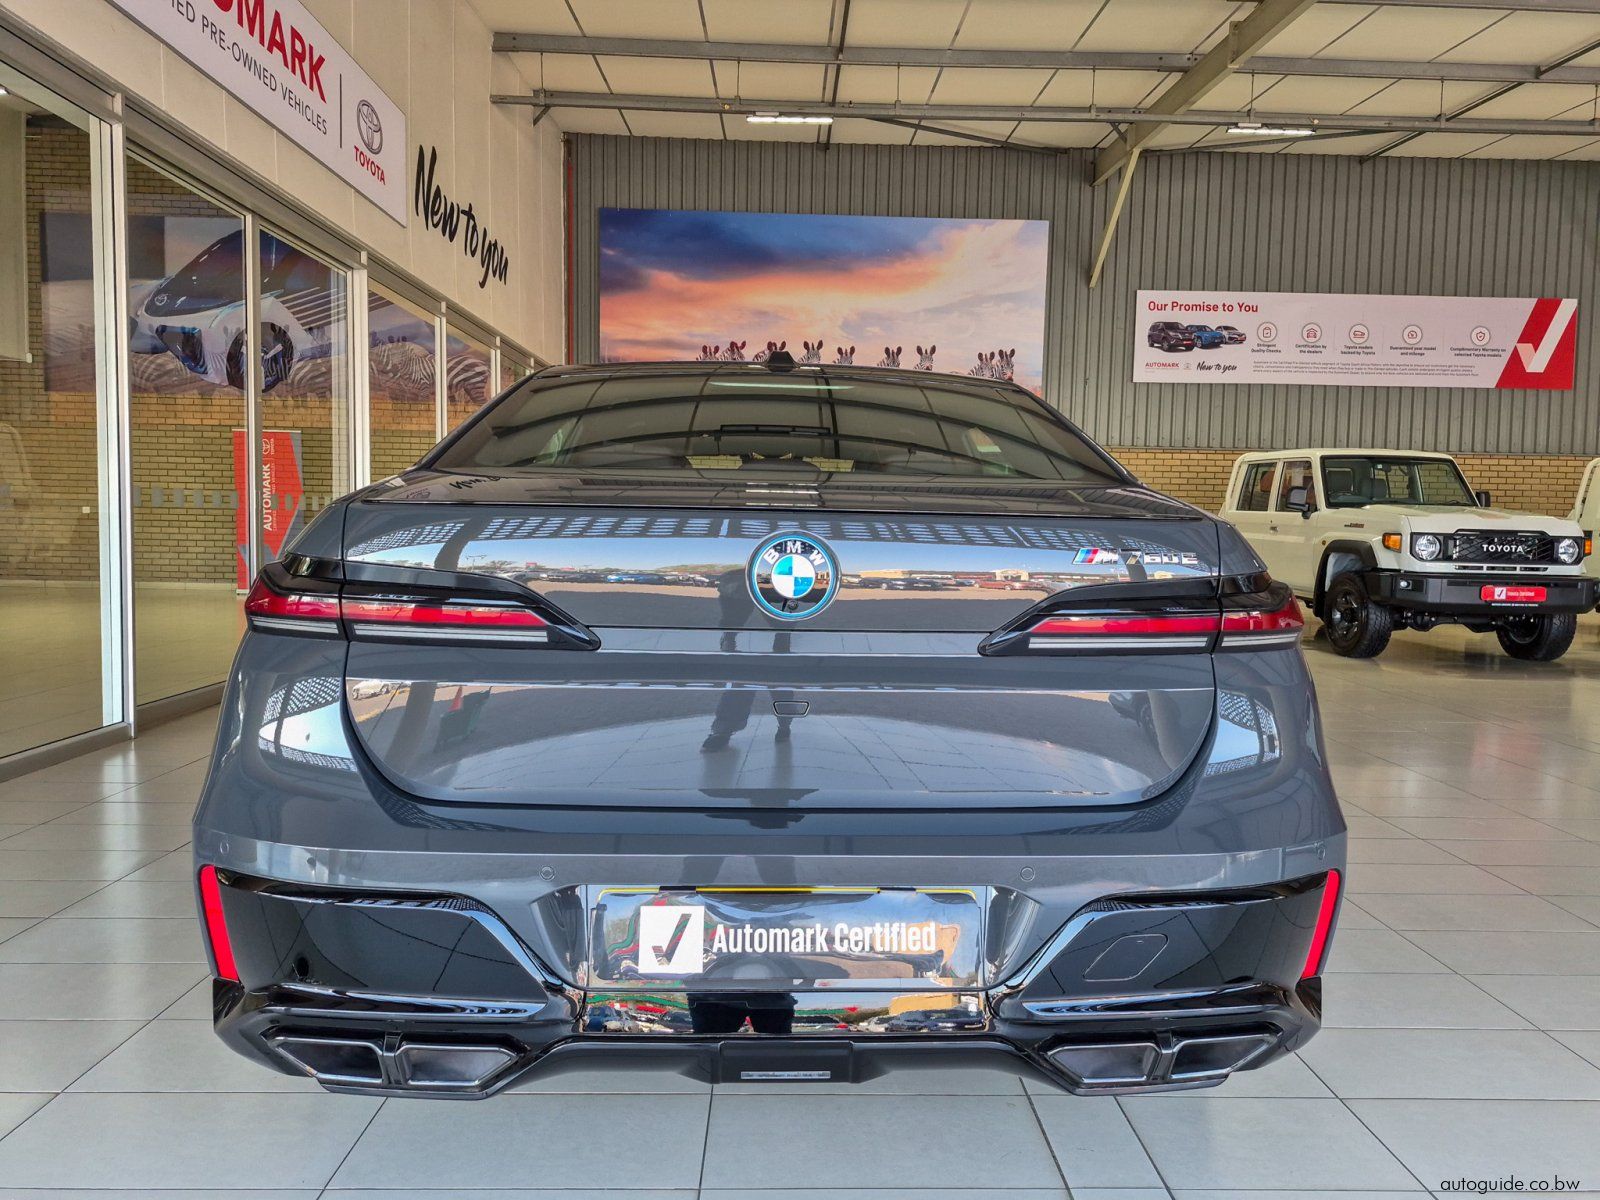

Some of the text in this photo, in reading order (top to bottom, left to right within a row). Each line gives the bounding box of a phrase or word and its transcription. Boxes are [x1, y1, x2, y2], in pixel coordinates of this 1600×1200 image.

[201, 14, 278, 92] PRE-OWNED
[280, 82, 328, 136] VEHICLES
[353, 145, 387, 186] TOYOTA
[414, 144, 509, 289] New to you
[1148, 301, 1259, 313] Our Promise to You
[1196, 361, 1238, 375] New to you
[262, 463, 272, 532] AUTOMARK
[763, 540, 826, 566] BMW
[1481, 544, 1525, 553] TOYOTA
[712, 921, 936, 953] Automark Certified
